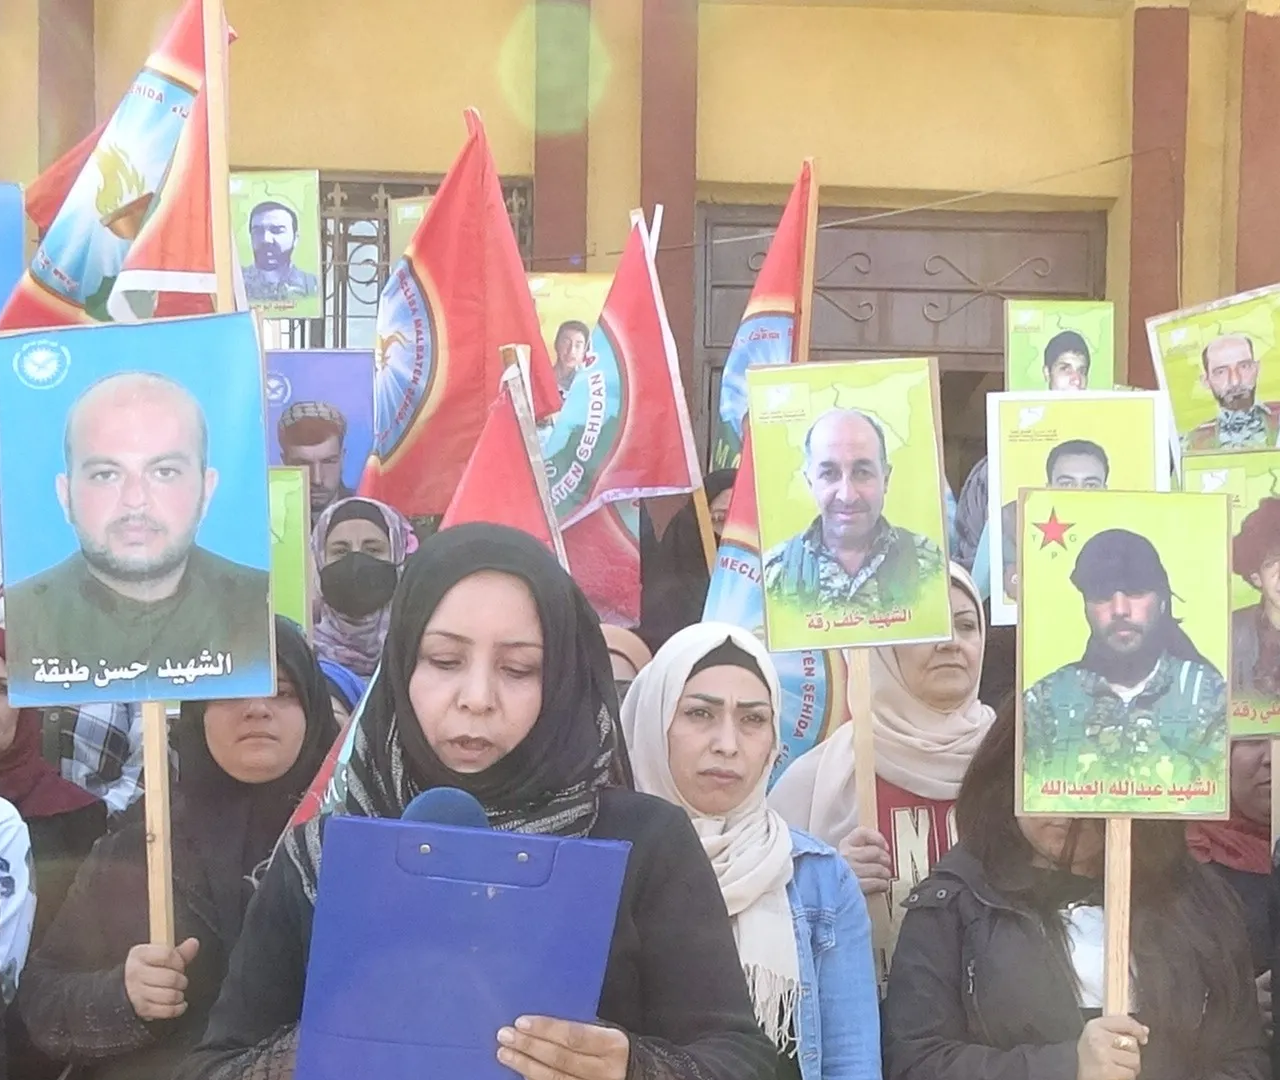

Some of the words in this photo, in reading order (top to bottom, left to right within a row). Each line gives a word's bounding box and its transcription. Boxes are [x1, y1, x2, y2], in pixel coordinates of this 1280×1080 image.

[719, 556, 761, 584] MECLI
[31, 657, 90, 684] طبقة
[94, 660, 150, 688] حسن
[157, 650, 233, 686] الشهيد
